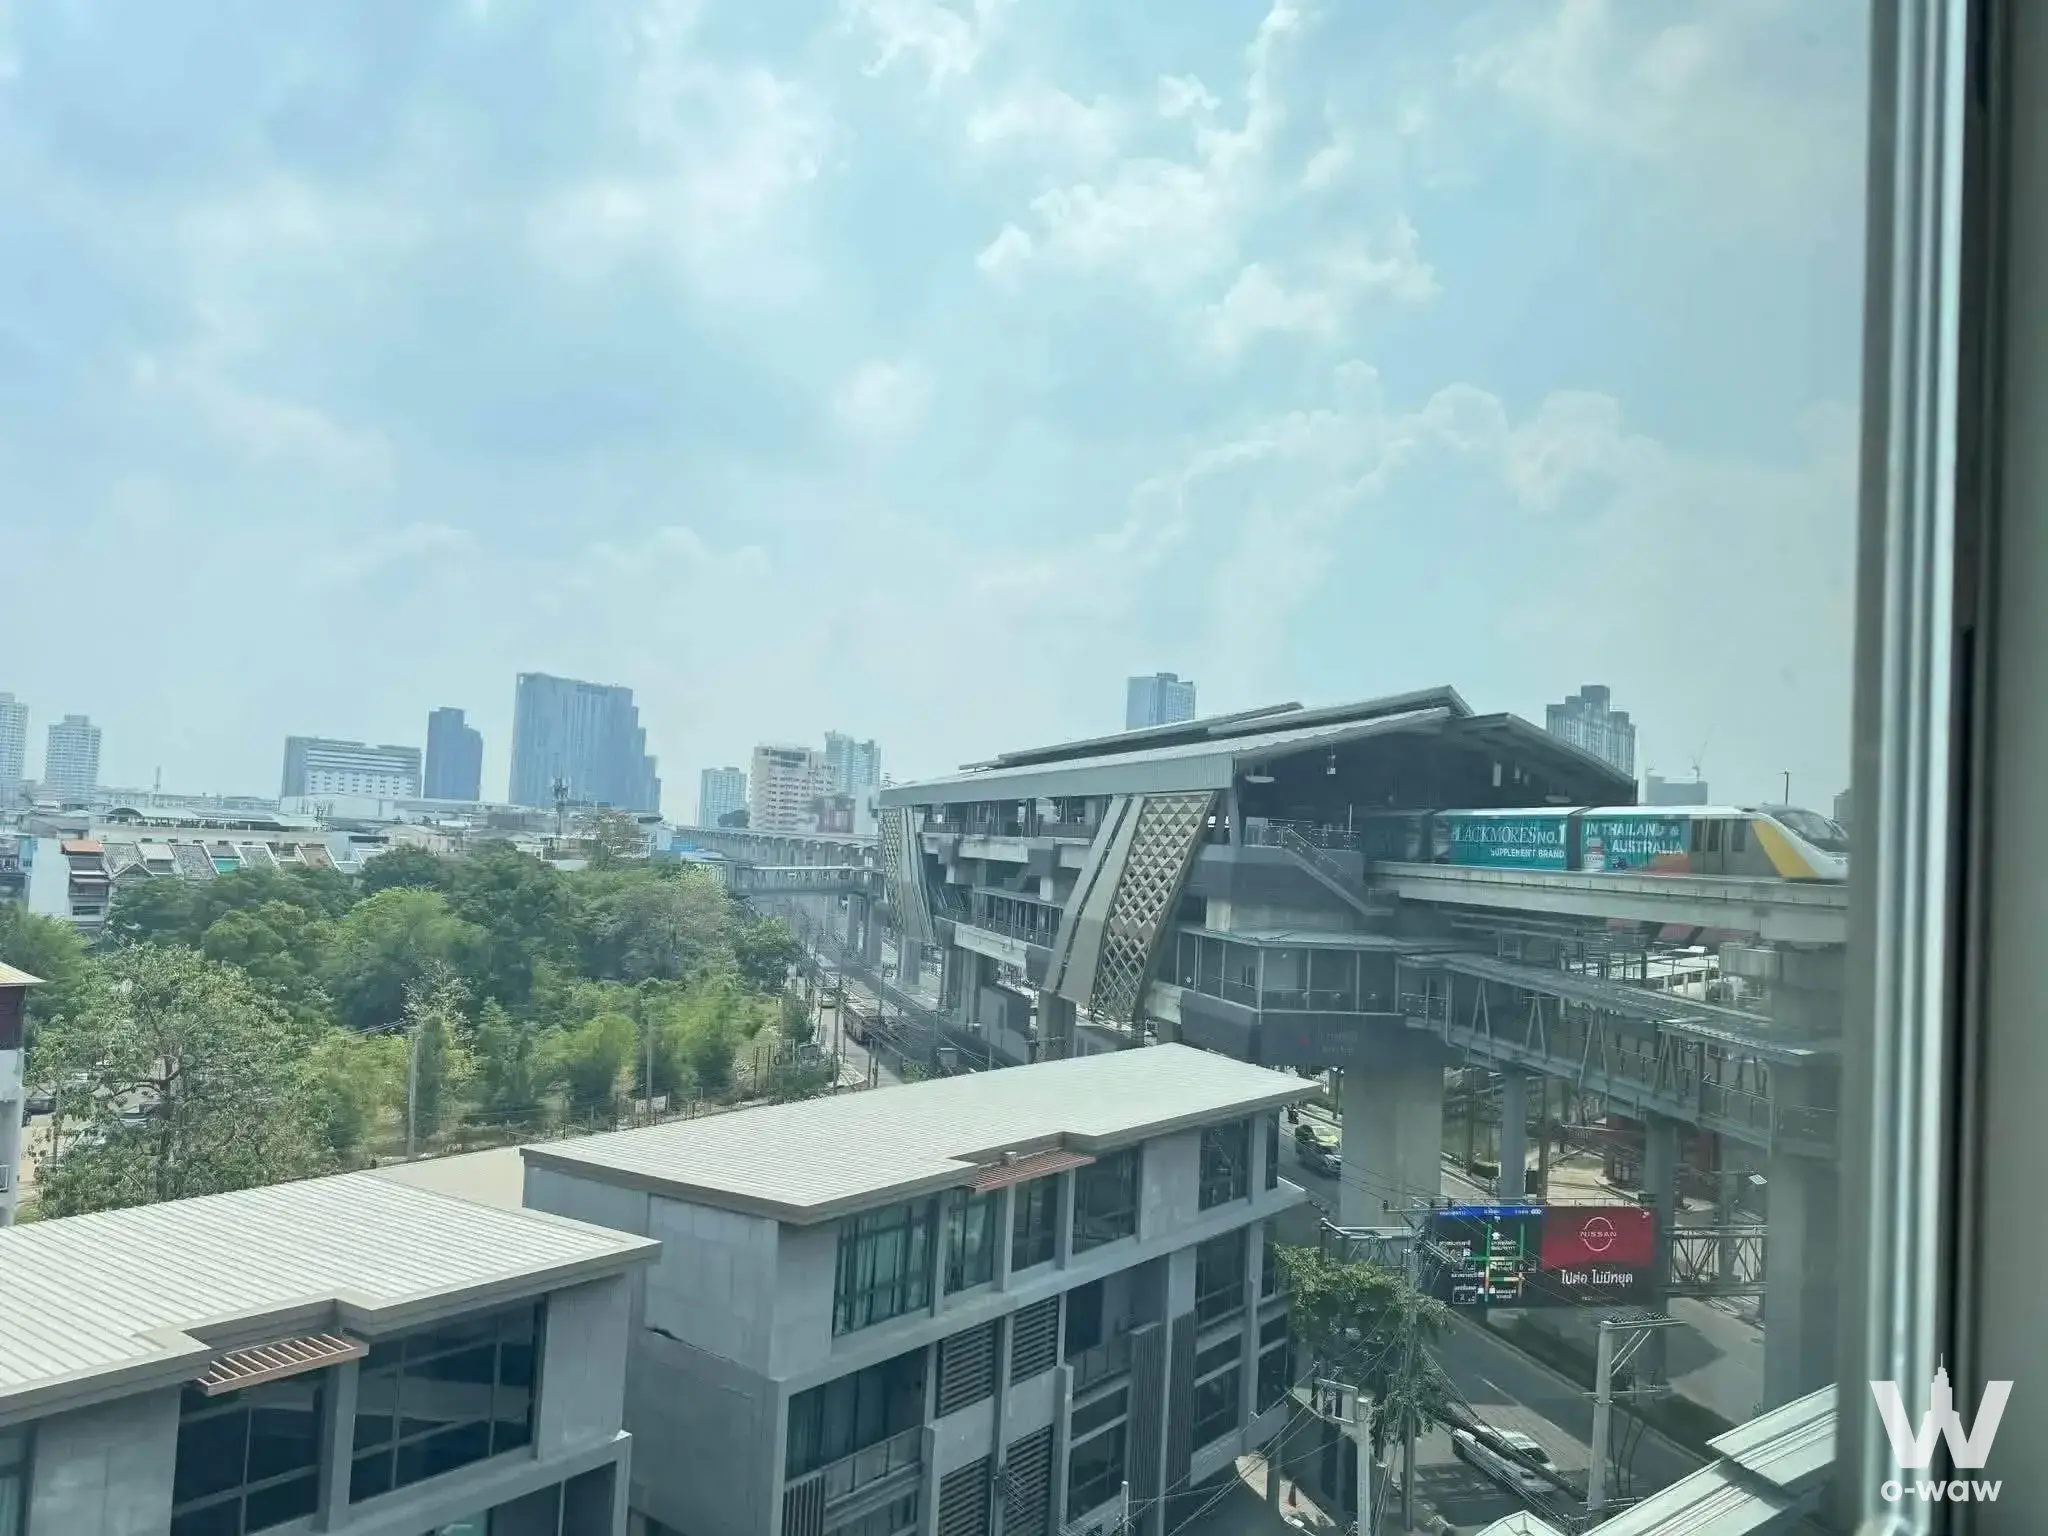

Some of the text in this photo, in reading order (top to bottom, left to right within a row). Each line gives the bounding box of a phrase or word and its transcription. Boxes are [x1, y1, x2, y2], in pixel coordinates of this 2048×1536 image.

[1586, 823, 1598, 836] IN
[1490, 847, 1565, 858] SUPPLEMENT BRAND
[1611, 838, 1685, 855] AUSTRALIA
[1561, 1269, 1633, 1287] ไปต่อ ไม่มีหยุด
